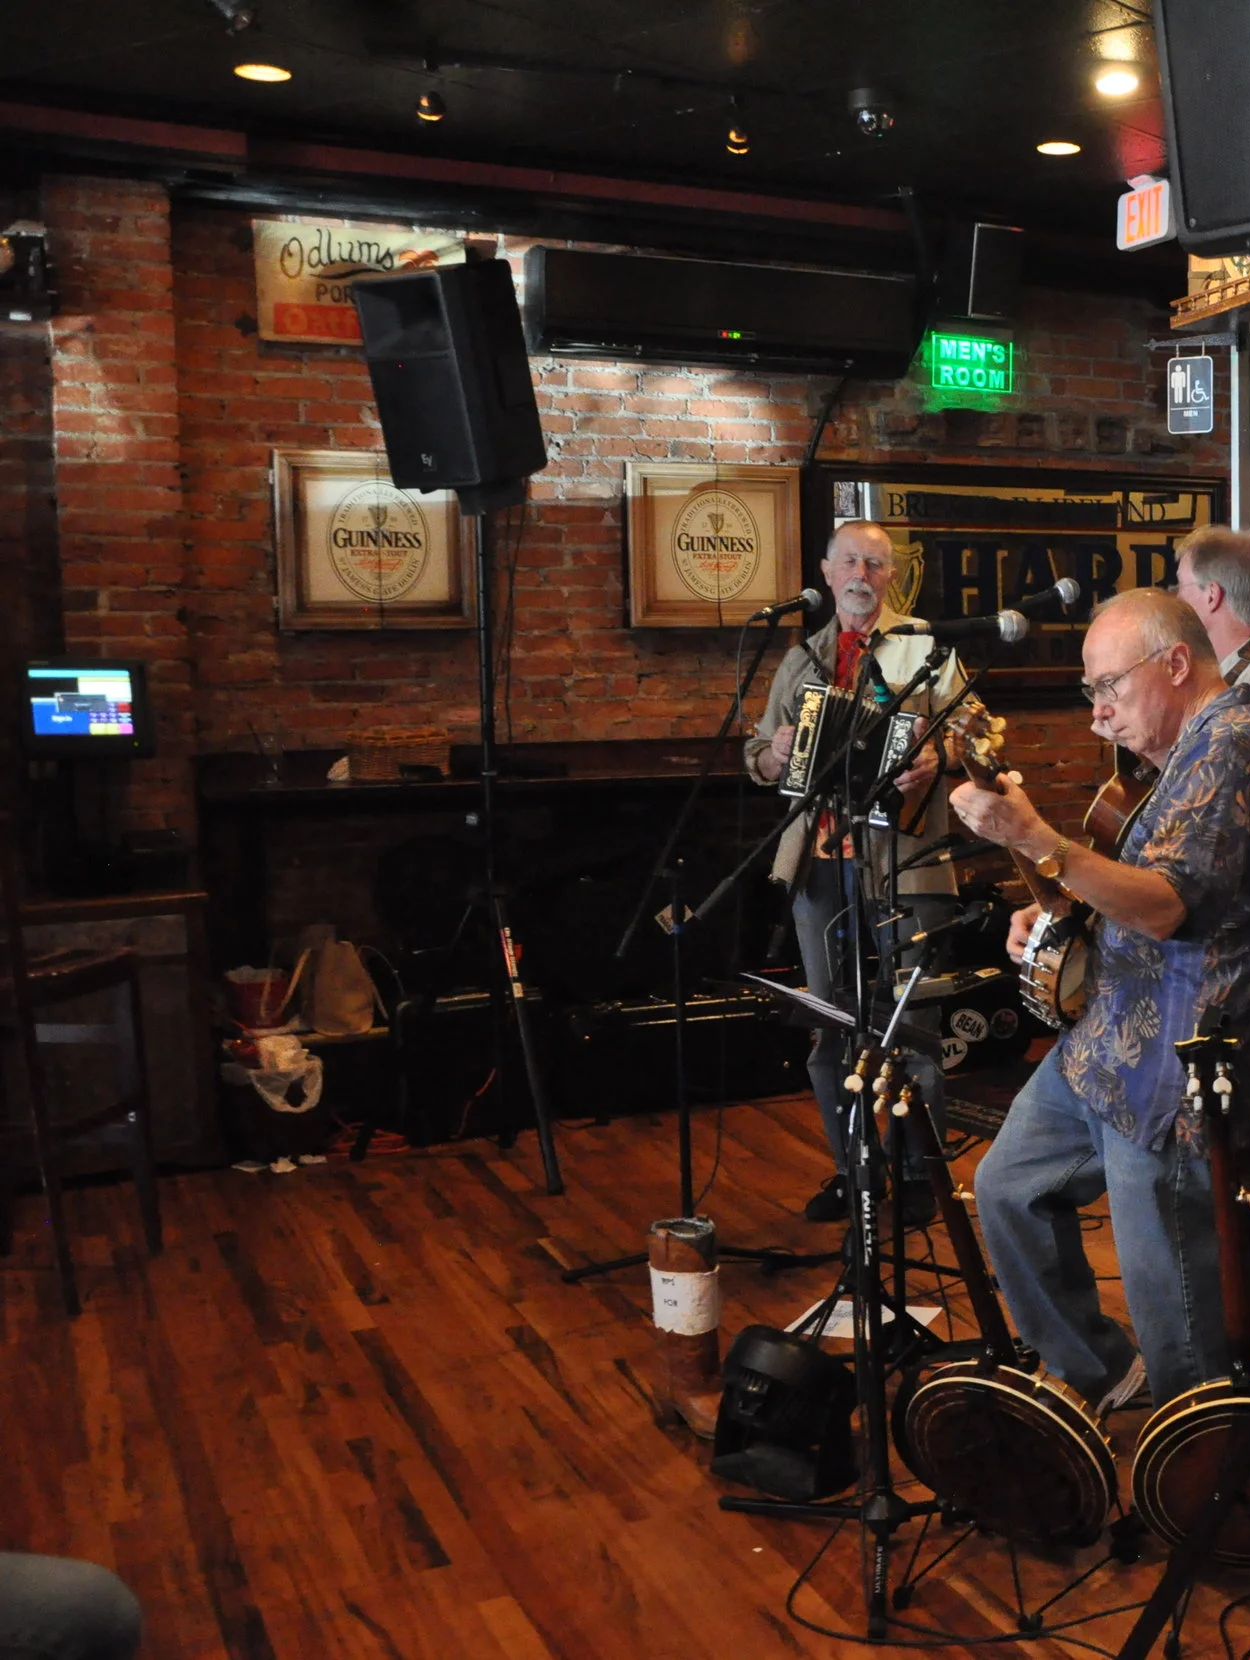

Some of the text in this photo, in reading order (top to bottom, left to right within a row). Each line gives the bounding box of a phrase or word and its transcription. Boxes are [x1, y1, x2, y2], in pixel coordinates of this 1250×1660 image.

[1124, 184, 1164, 244] EXIT
[279, 228, 395, 279] Odlums
[315, 283, 355, 303] POR
[940, 339, 1006, 364] MEN'S
[940, 365, 1005, 389] ROOM
[1183, 410, 1198, 418] MEN
[333, 527, 422, 550] GUINNESS
[677, 532, 754, 553] GUINNESS
[955, 1013, 985, 1039] BEAN
[942, 1042, 962, 1058] VL
